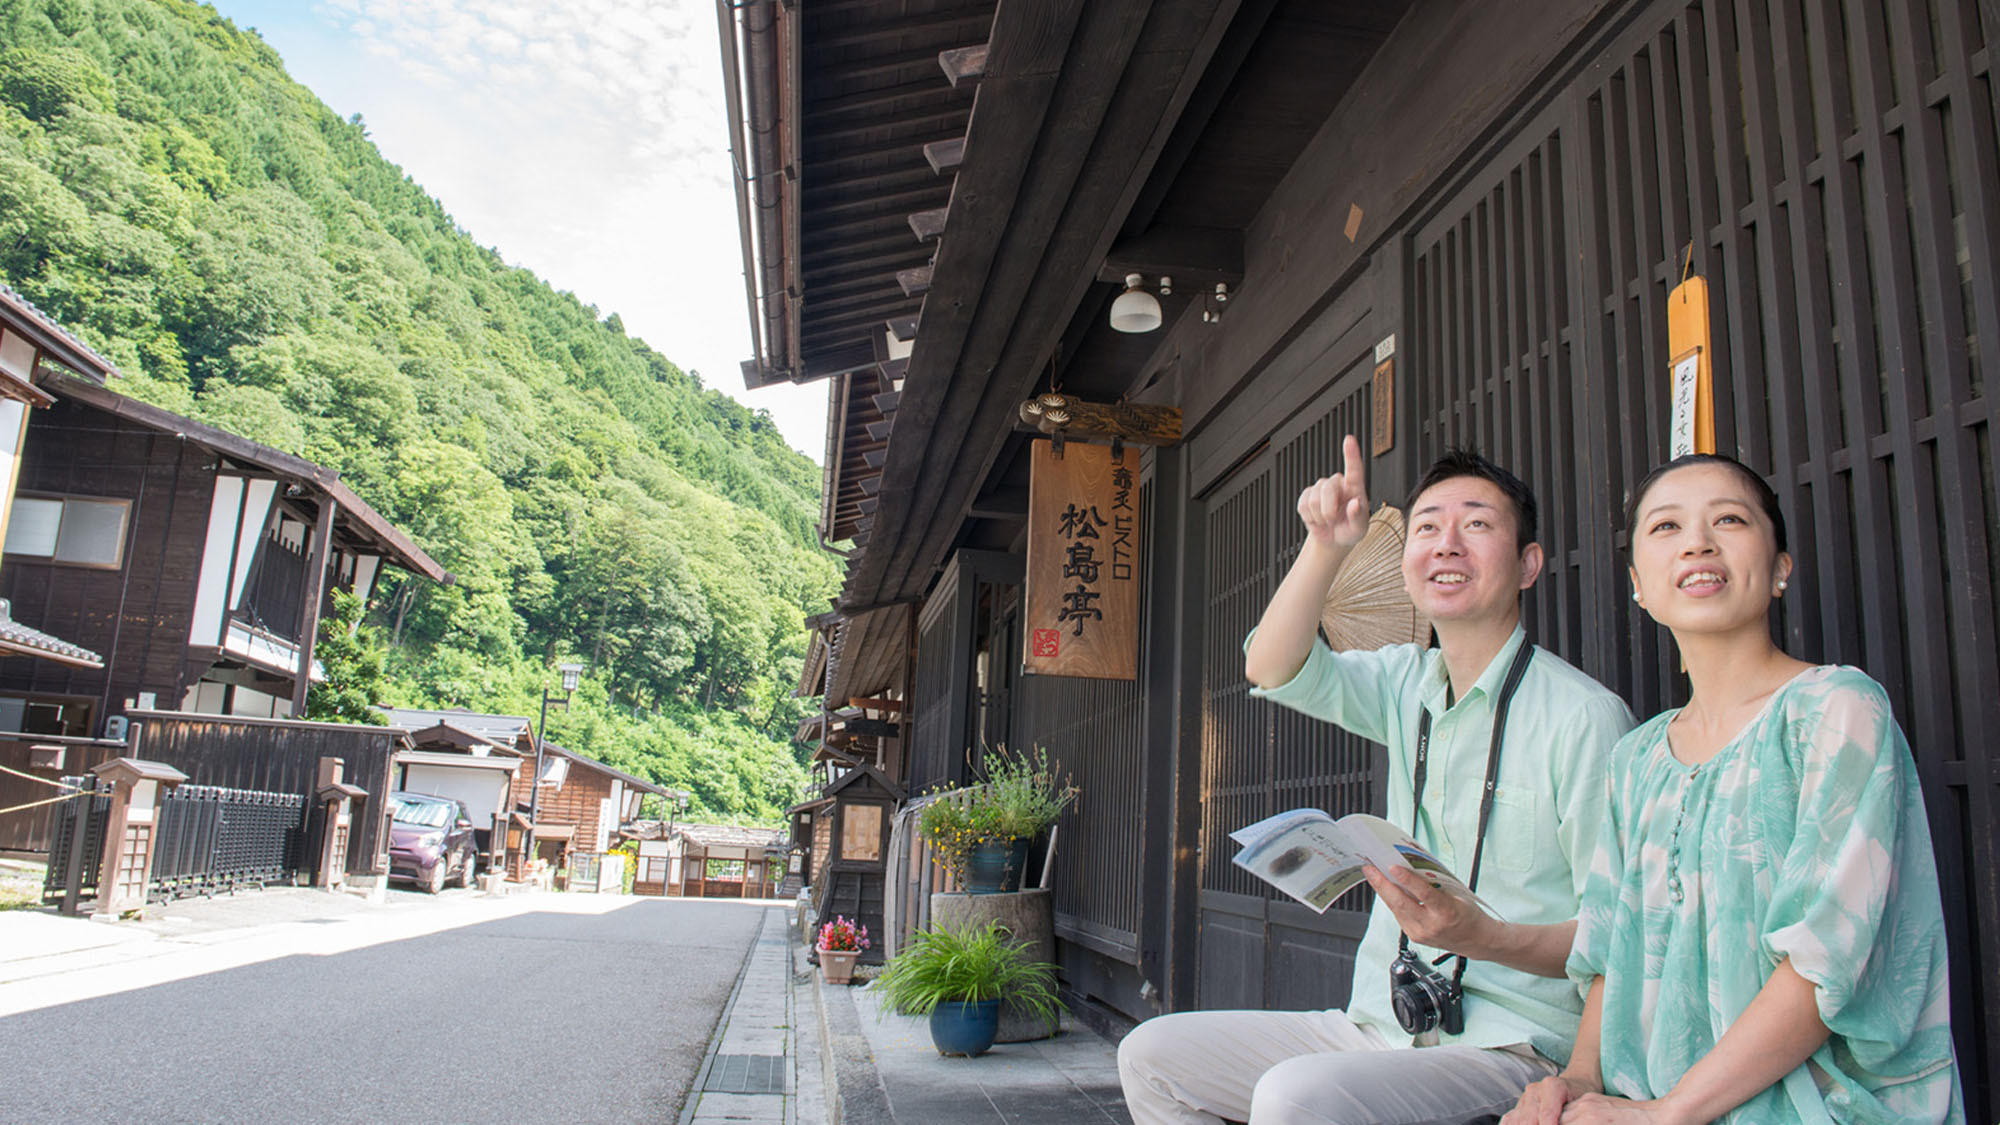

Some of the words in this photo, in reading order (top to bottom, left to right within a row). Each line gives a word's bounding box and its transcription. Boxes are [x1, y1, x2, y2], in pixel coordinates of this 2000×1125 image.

[1057, 503, 1108, 637] 松島亭
[1419, 735, 1428, 762] SONY
